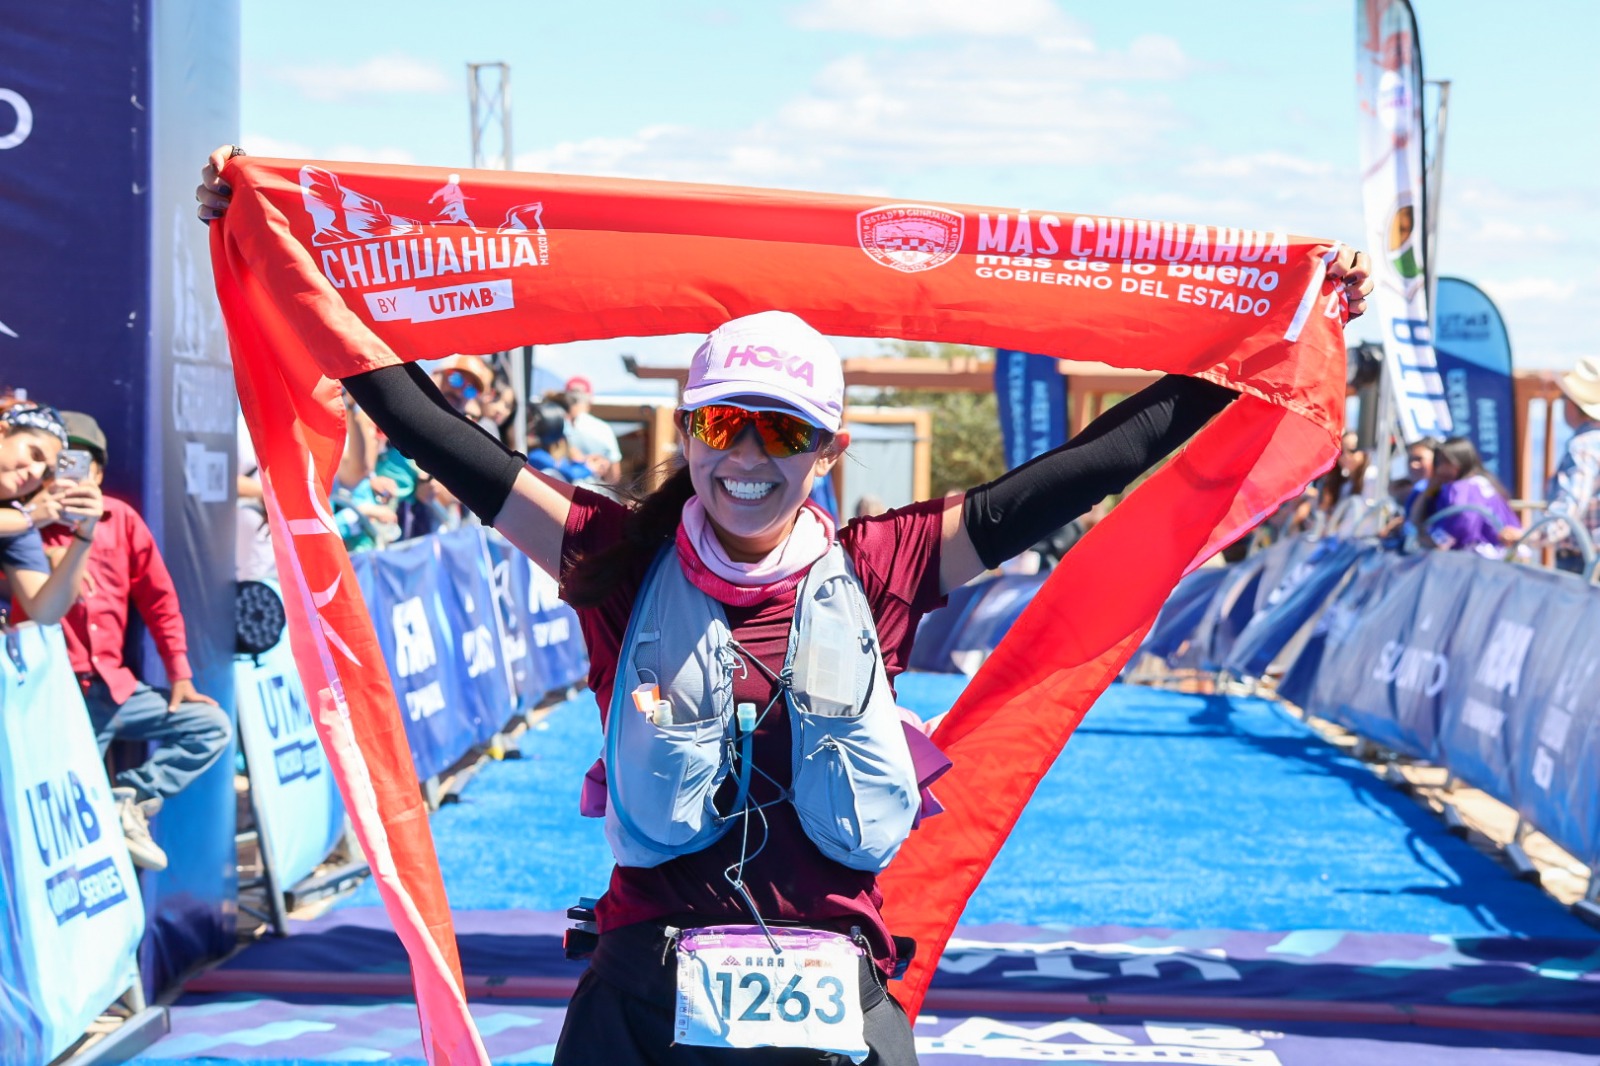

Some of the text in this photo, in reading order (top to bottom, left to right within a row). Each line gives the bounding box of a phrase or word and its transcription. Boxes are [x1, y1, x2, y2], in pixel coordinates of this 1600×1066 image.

[540, 236, 549, 265] MEXICO
[977, 208, 1061, 256] MÁS
[1070, 217, 1289, 264] CHIHUAHUA
[320, 236, 538, 288] CHIHUAHUA
[975, 252, 1279, 292] más de lo bueno
[378, 287, 495, 314] BY UTMB
[975, 267, 1270, 317] GOBIERNO DEL ESTADO
[724, 345, 814, 387] HOKA
[257, 676, 312, 739] UTM
[26, 770, 101, 867] UTMB
[715, 972, 846, 1024] 1263
